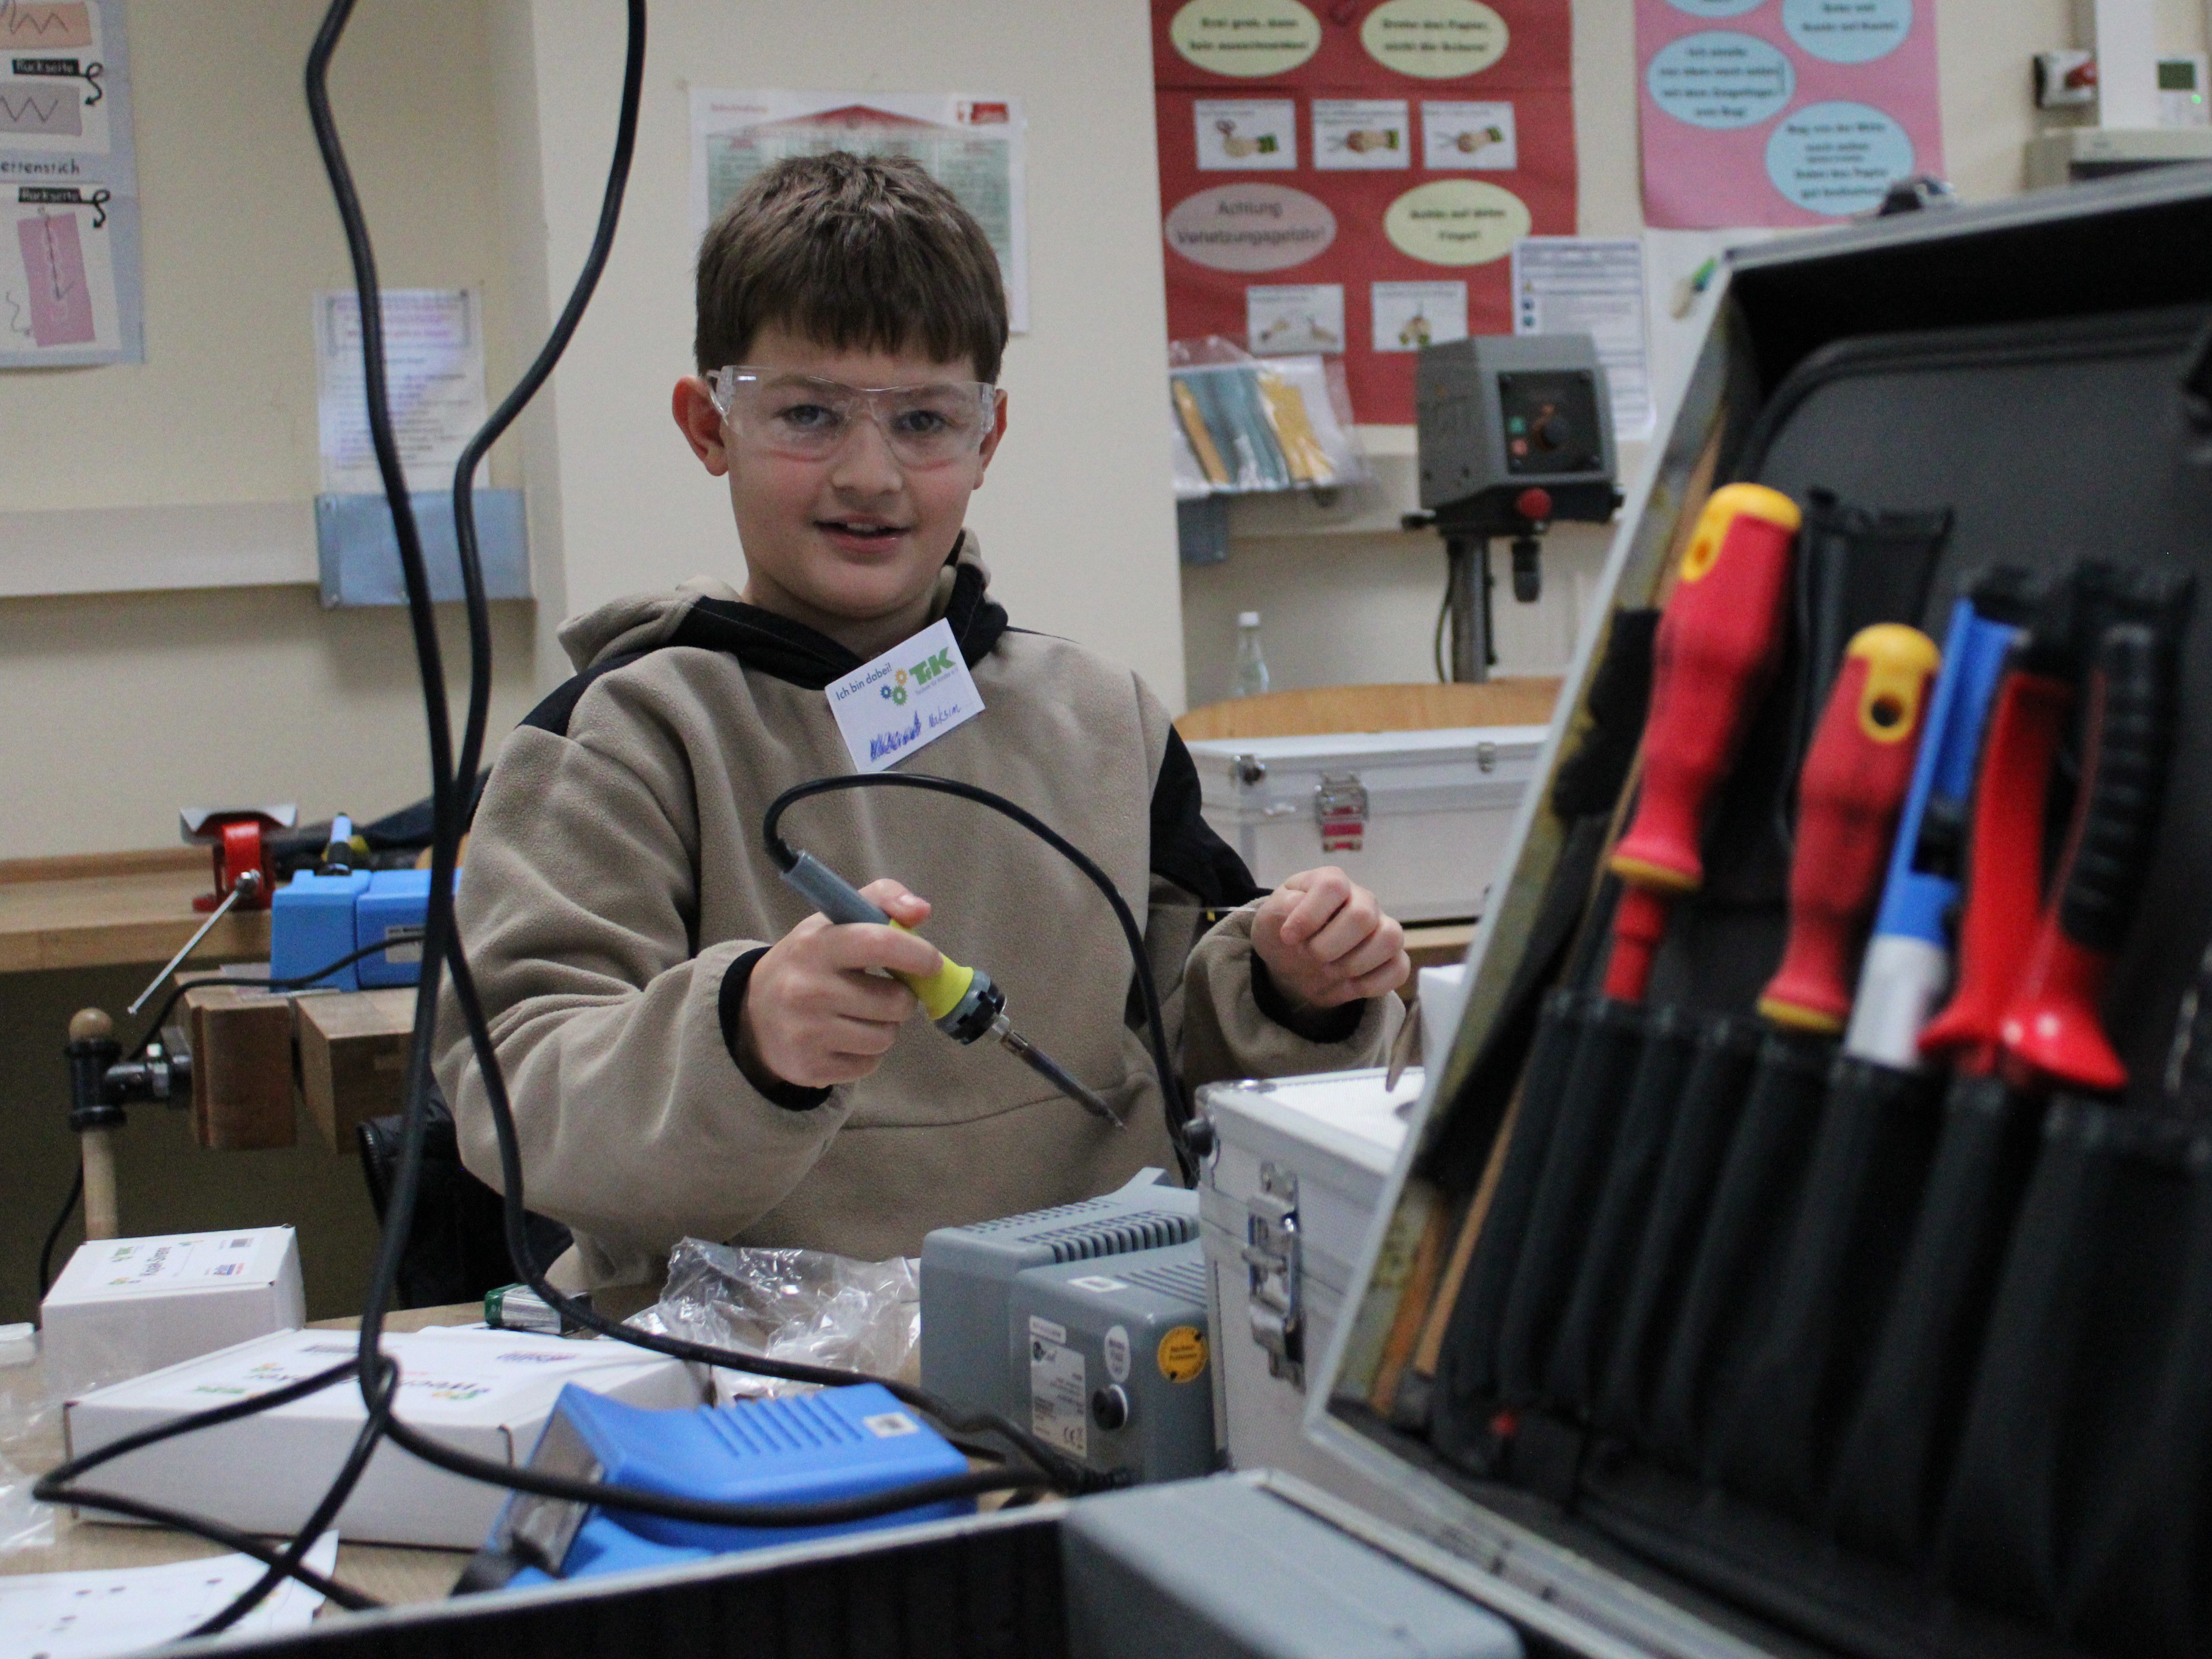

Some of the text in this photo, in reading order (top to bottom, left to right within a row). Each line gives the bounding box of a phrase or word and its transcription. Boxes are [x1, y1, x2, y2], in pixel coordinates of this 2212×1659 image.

[0, 159, 80, 174] ettenstich
[836, 662, 892, 700] Ich bin dabei!
